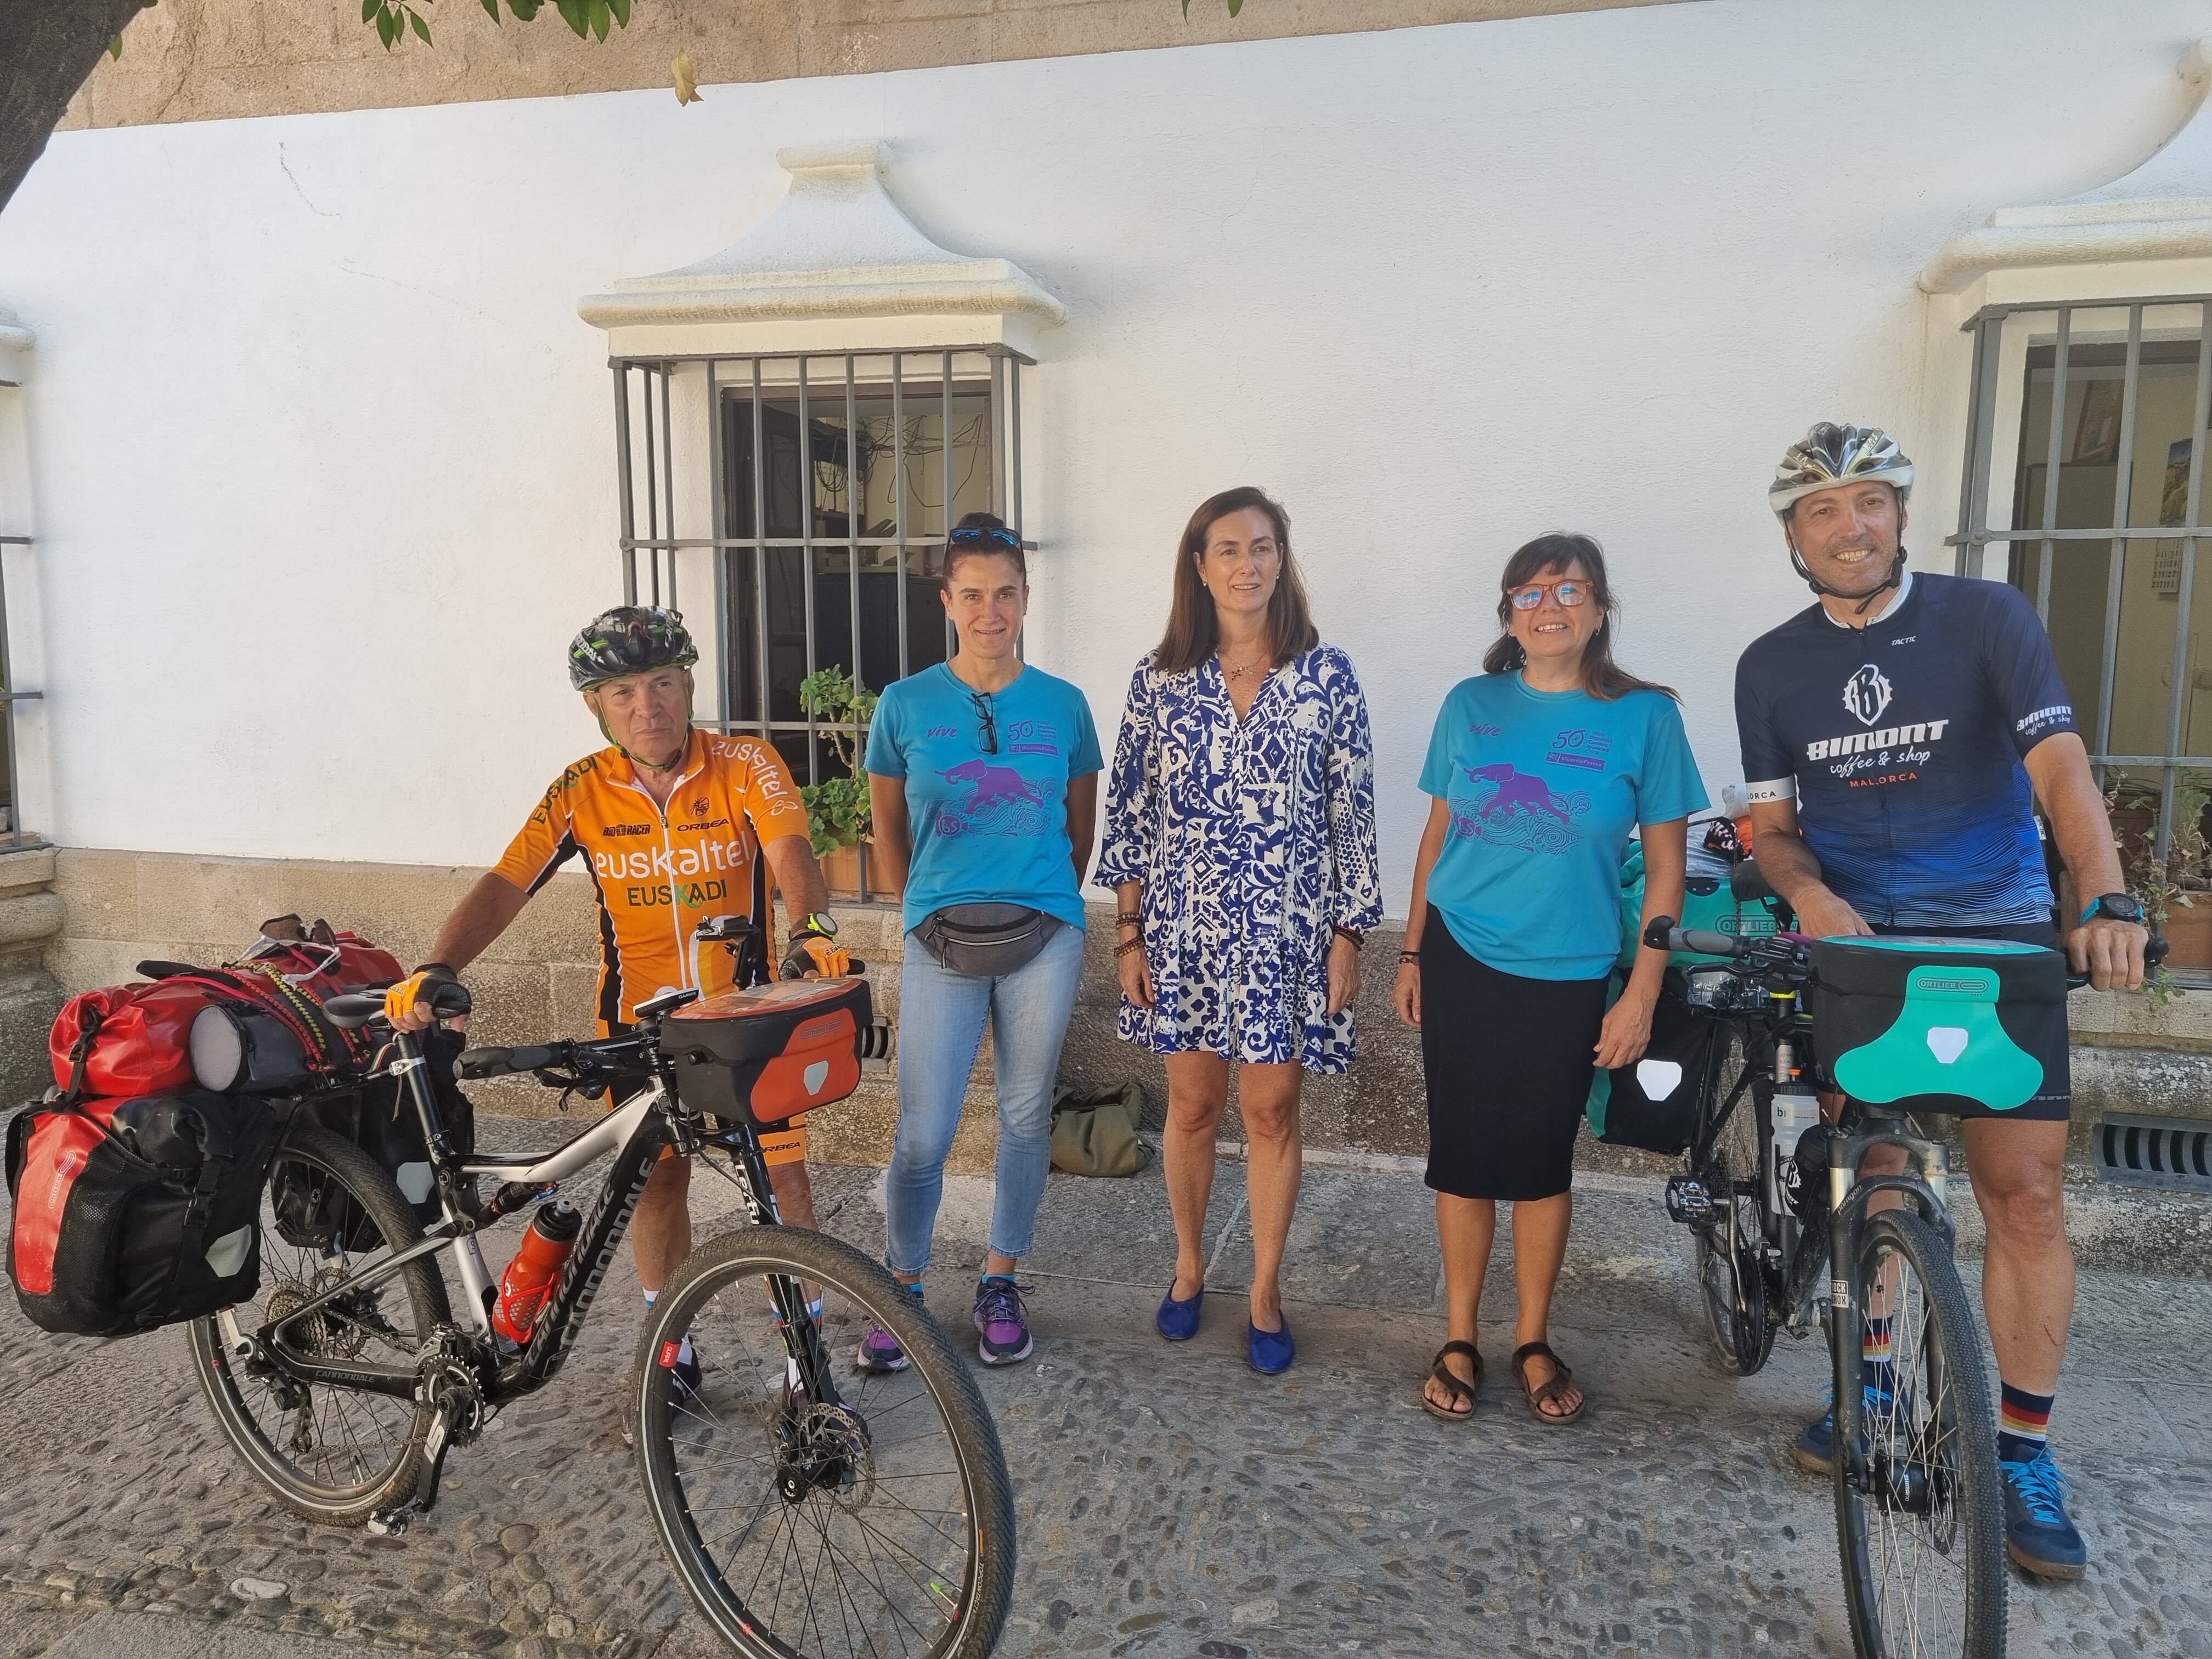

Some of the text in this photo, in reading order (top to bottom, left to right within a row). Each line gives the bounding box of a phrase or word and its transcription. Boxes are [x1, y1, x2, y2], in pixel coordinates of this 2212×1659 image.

[1891, 635, 1916, 646] TACTIC
[2017, 706, 2072, 732] BIMONT
[2025, 714, 2071, 736] coffee & shop
[1008, 720, 1034, 741] 50
[1552, 729, 1586, 749] 50
[1807, 719, 1949, 761] BIMONT
[1830, 745, 1931, 778] coffee & shop
[677, 818, 729, 832] ORBEA
[596, 830, 751, 879] euskaltel
[627, 879, 727, 909] EUSKADI
[763, 1141, 801, 1153] RBEA
[1837, 1185, 1863, 1216] paragon
[315, 1370, 376, 1383] CANNONDALE
